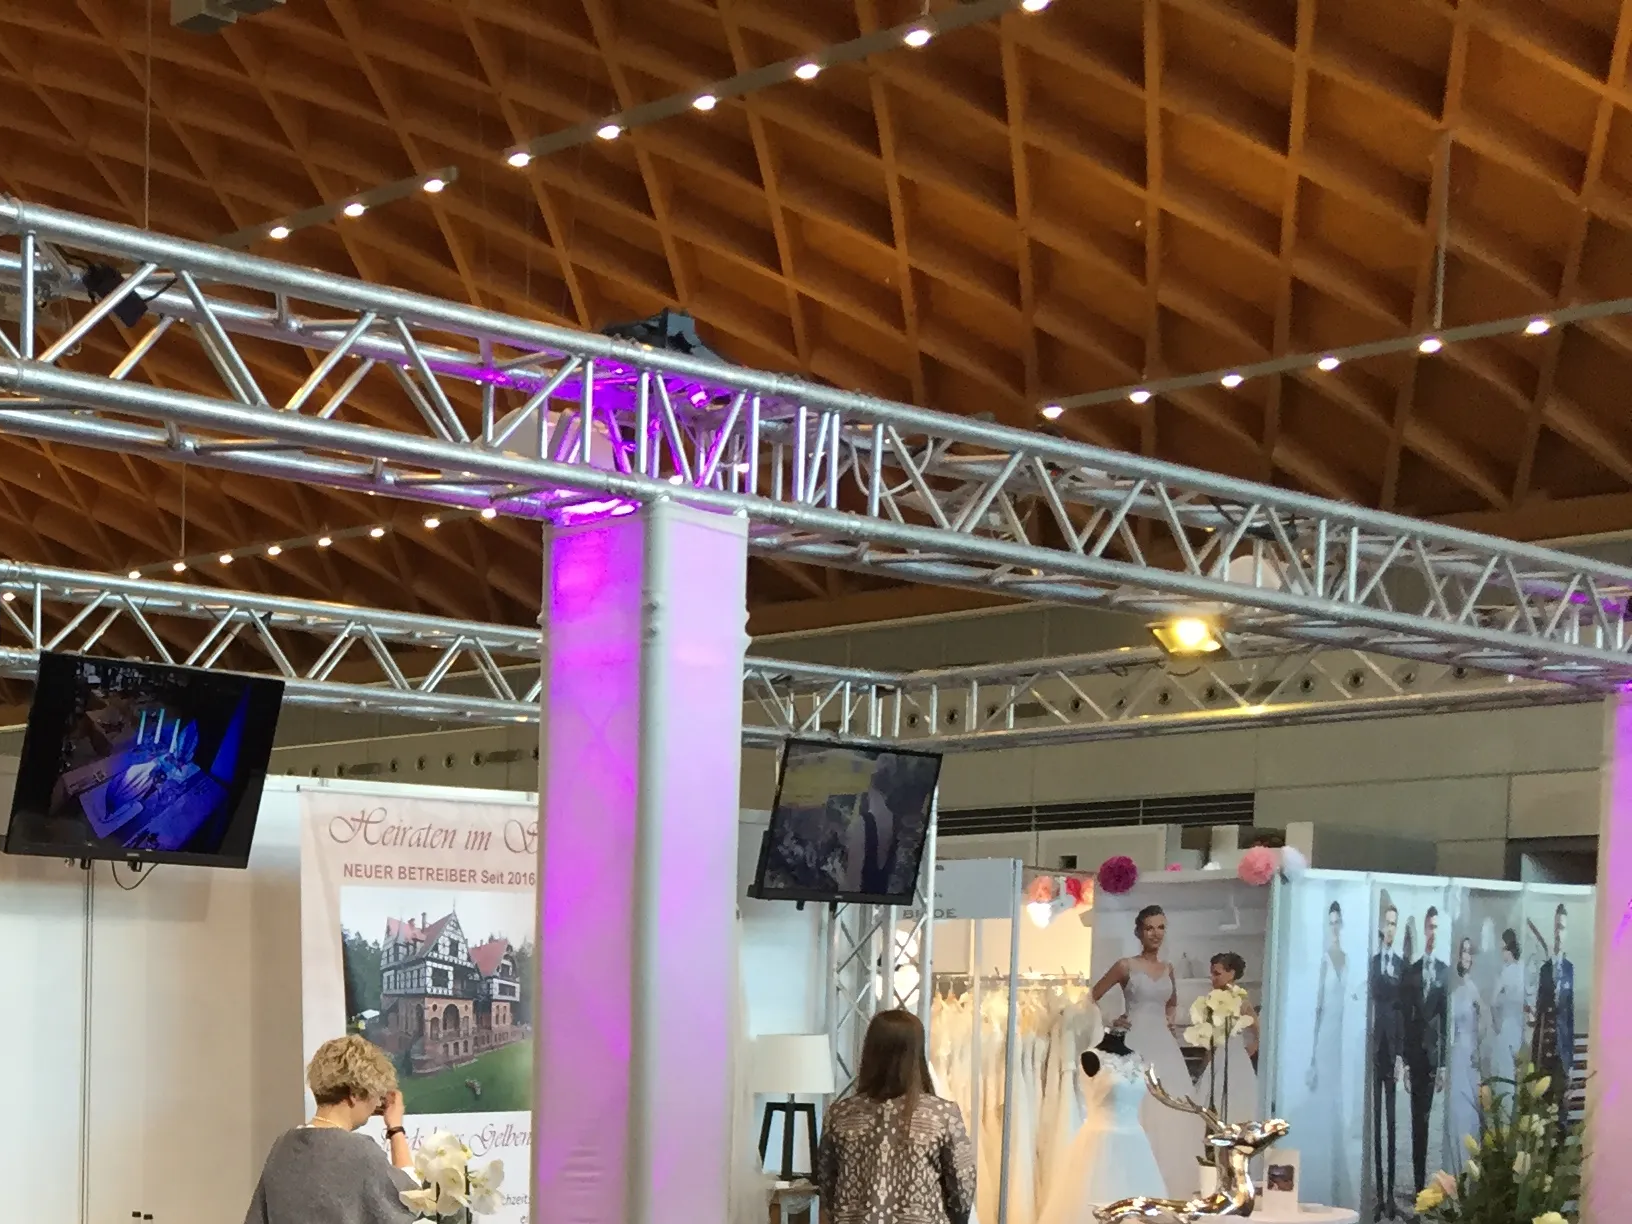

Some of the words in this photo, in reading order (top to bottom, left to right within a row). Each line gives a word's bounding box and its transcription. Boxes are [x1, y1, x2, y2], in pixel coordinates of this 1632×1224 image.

[328, 806, 457, 850] Heiraten
[464, 823, 492, 851] im
[343, 862, 394, 881] NEUER
[397, 865, 477, 885] BETREIBER
[480, 869, 505, 885] Seit
[507, 871, 536, 886] 2016
